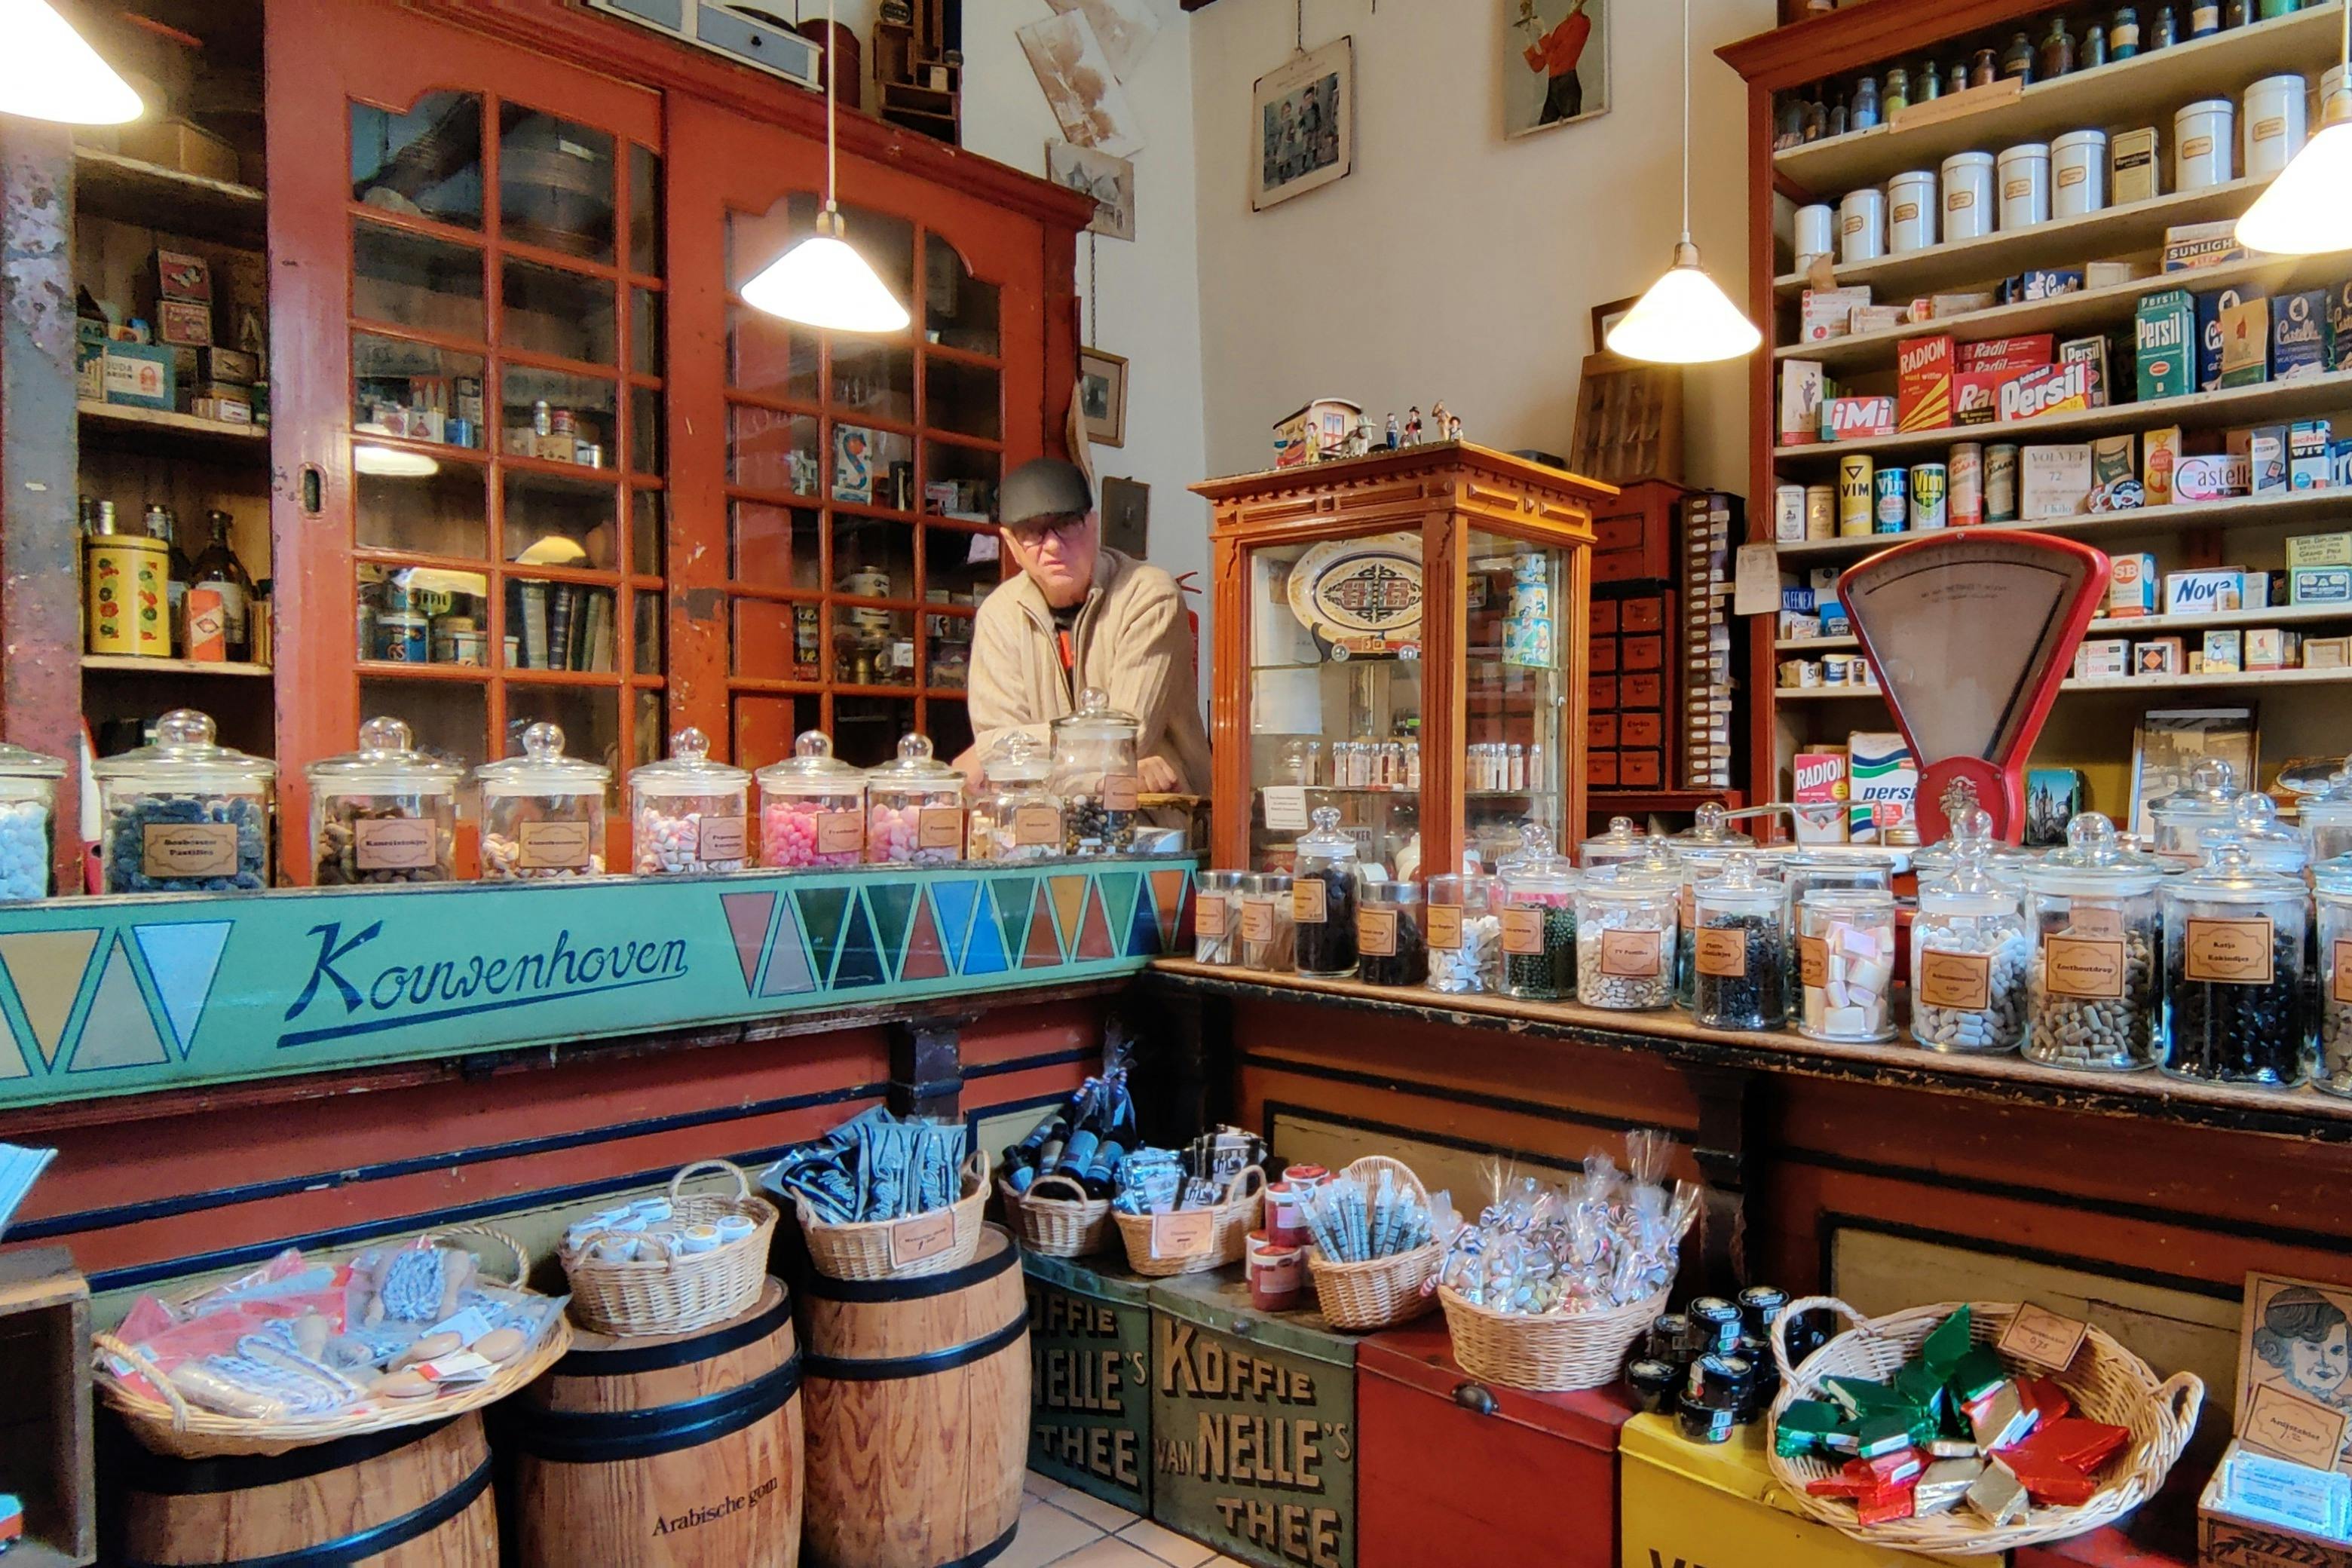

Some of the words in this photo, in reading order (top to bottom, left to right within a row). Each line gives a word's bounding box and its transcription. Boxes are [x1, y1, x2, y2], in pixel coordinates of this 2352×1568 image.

[2142, 291, 2179, 308] Persil
[2138, 312, 2180, 350] Persil
[1900, 337, 1945, 375] RADION
[1974, 340, 2007, 358] Radil
[2067, 343, 2099, 363] Persil
[1975, 359, 2007, 373] Radil
[1958, 384, 1995, 412] Ra
[2001, 363, 2084, 421] Persil
[1833, 399, 1891, 430] iMi
[2292, 446, 2325, 457] WIT
[1842, 483, 1870, 497] VIM
[1877, 475, 1906, 495] Vim
[1914, 470, 1943, 492] Vim
[2049, 472, 2063, 482] 72
[2113, 565, 2139, 578] SB
[1783, 591, 1814, 609] KLEENEX
[1797, 757, 1845, 791] RADION
[284, 919, 689, 1022] Kouwenhoven
[2056, 962, 2113, 975] Zoethoutdrop
[1030, 1291, 1115, 1332] OFFIE
[1162, 1318, 1315, 1400] KOFFIE
[1037, 1424, 1138, 1487] THEE
[1156, 1438, 1193, 1478] VAN
[1199, 1412, 1351, 1487] NELLE'S
[652, 1495, 746, 1536] Arabische
[748, 1477, 778, 1508] gom
[1216, 1497, 1340, 1568] THEE
